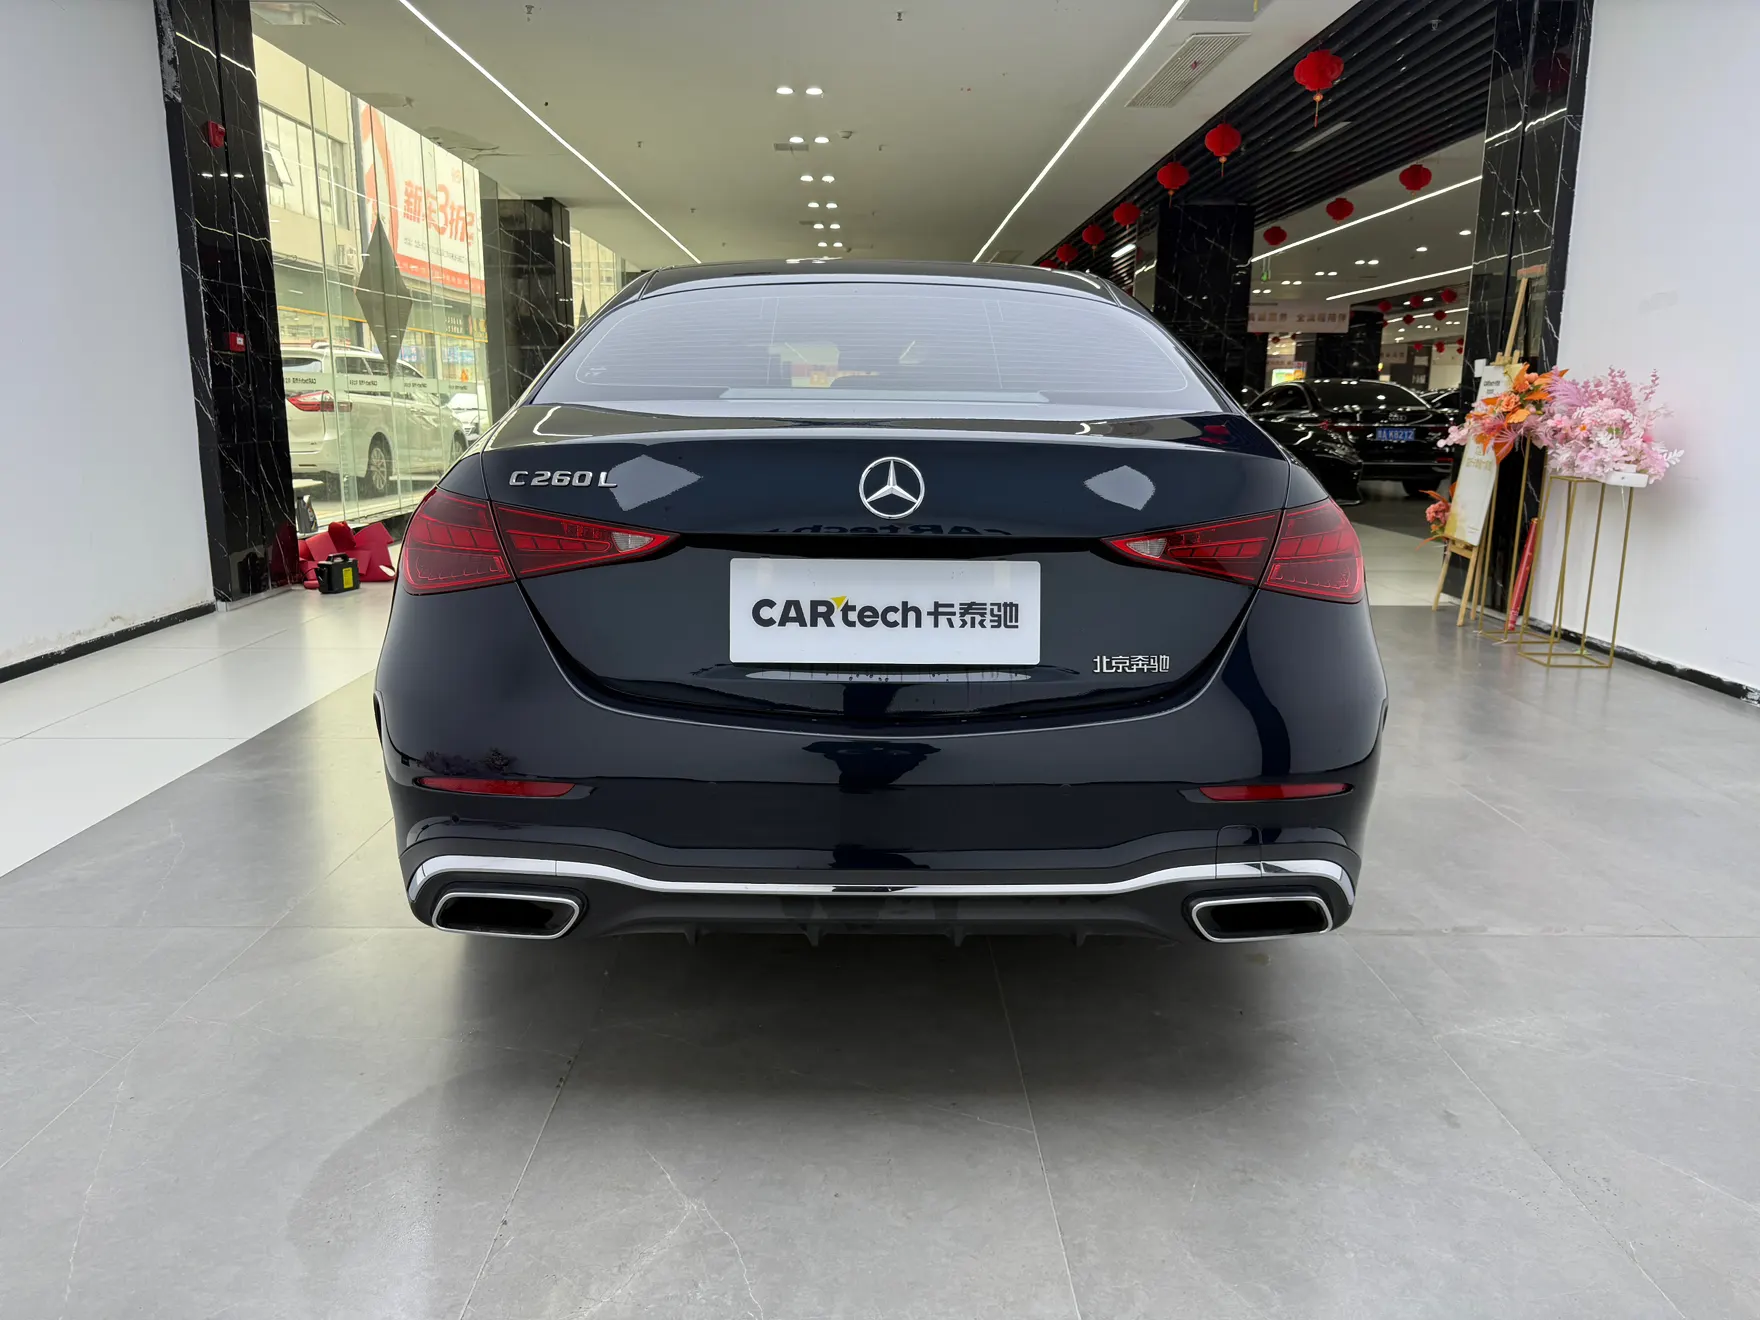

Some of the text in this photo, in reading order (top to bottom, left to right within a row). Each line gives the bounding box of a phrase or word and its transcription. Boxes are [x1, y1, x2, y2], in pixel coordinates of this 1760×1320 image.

[509, 470, 618, 488] C 260 L
[751, 598, 1019, 629] CARtech 卡泰驰
[1093, 654, 1170, 673] 北京奔驰
